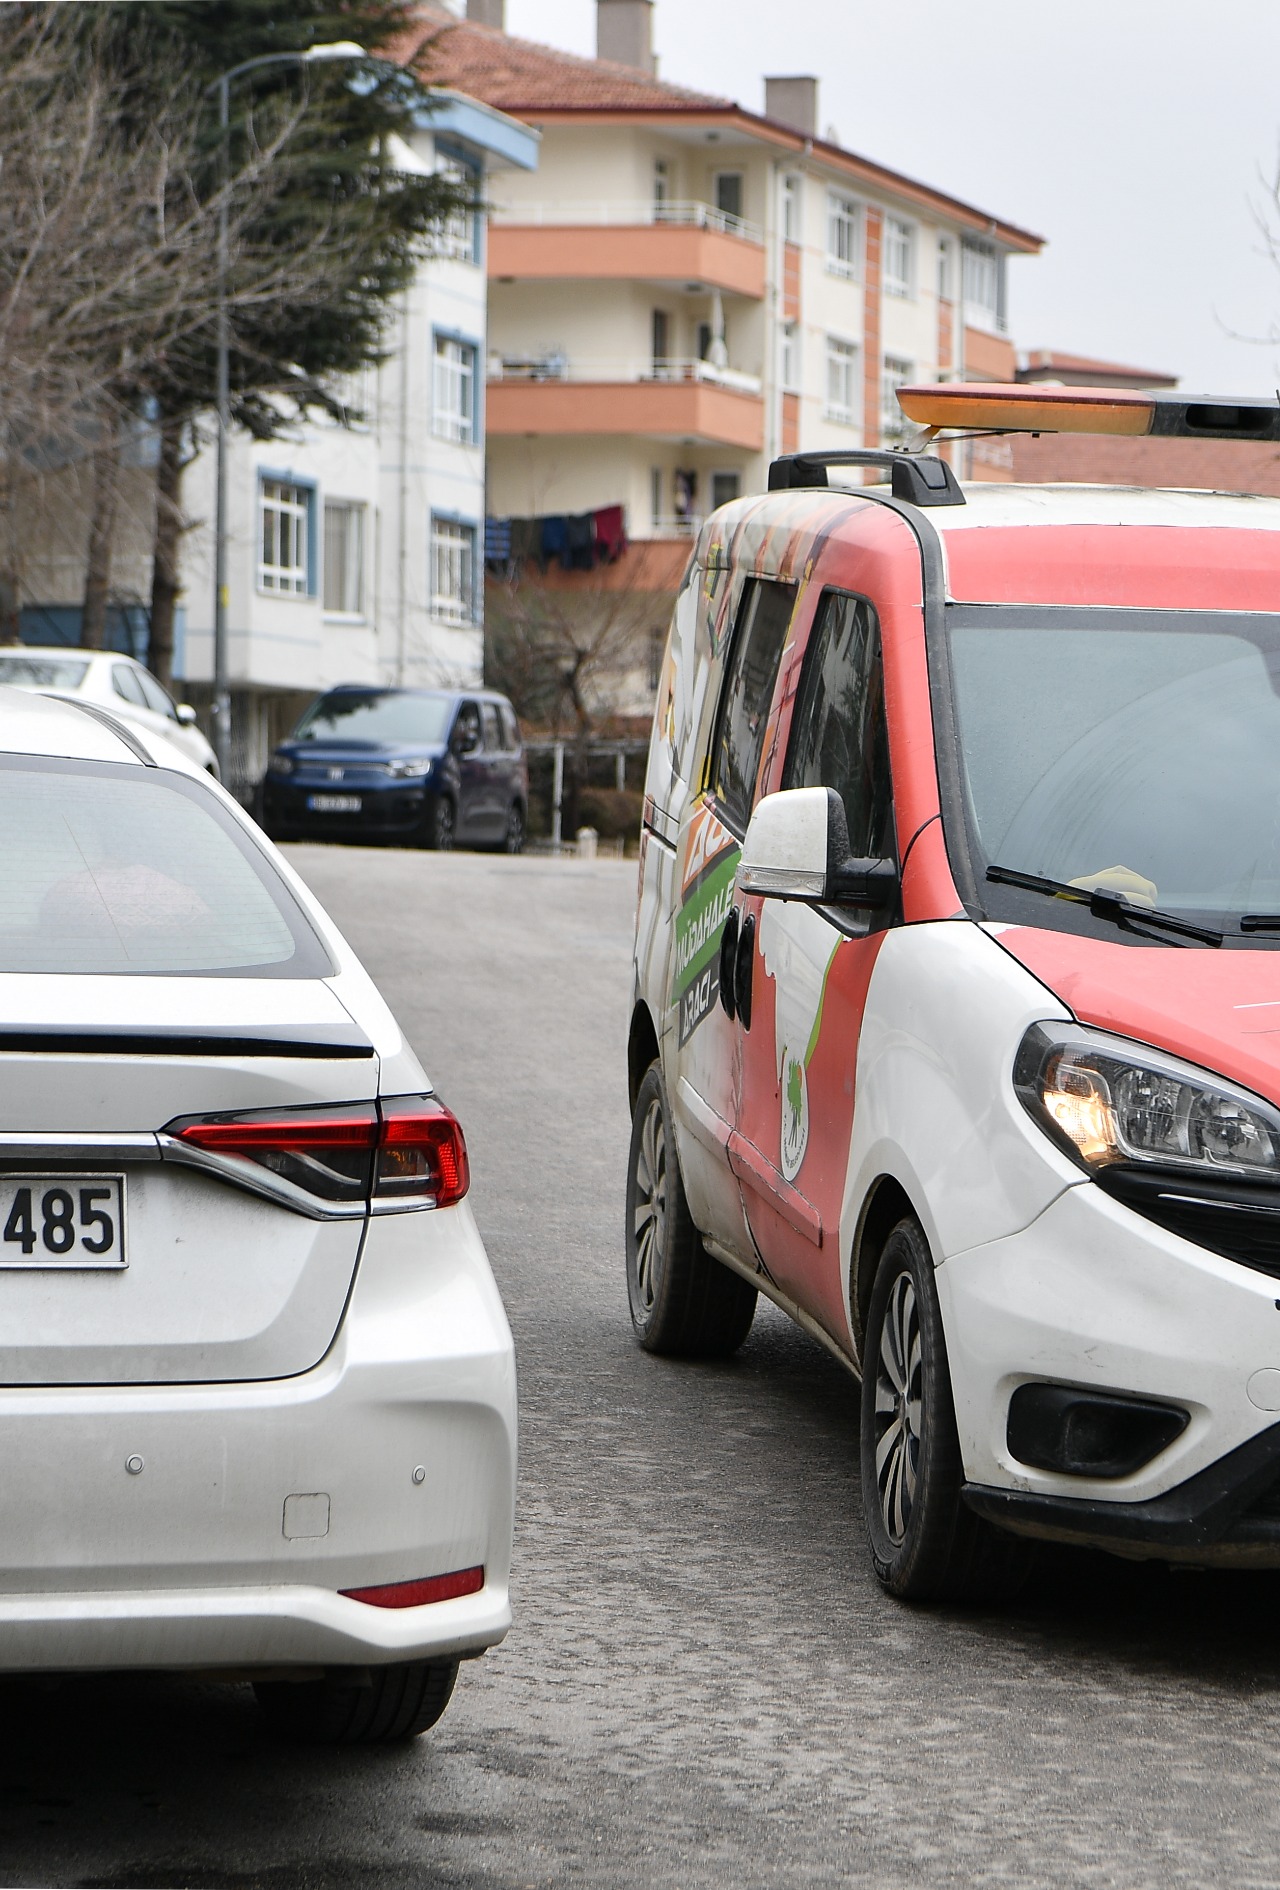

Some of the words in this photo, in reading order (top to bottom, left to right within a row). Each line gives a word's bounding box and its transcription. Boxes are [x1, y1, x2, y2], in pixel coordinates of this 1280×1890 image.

[677, 877, 735, 979] MÜDAHALE
[682, 969, 711, 1040] ARACI
[3, 1188, 114, 1254] 485
